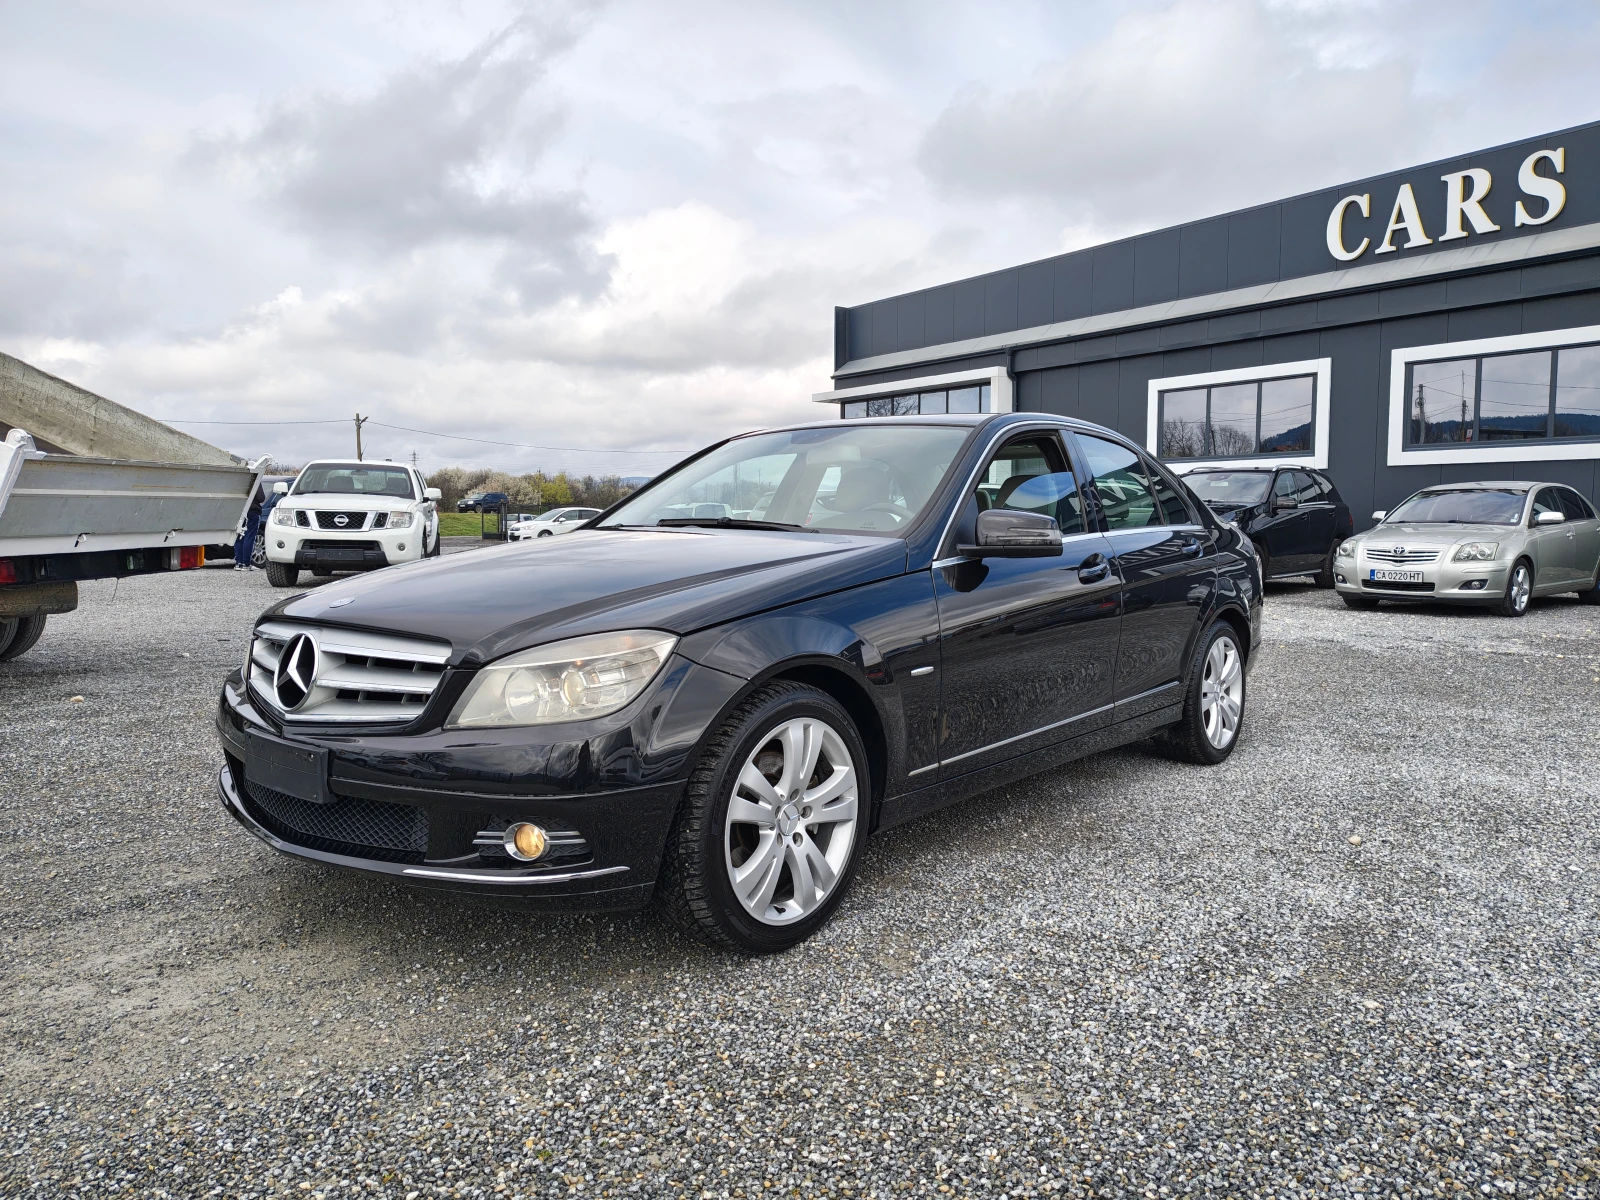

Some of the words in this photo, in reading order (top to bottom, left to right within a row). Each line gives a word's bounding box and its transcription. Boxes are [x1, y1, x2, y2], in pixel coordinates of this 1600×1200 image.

[1326, 147, 1566, 262] CARS
[1376, 572, 1386, 580] CA
[1388, 572, 1408, 580] 0220
[1410, 572, 1421, 582] HT
